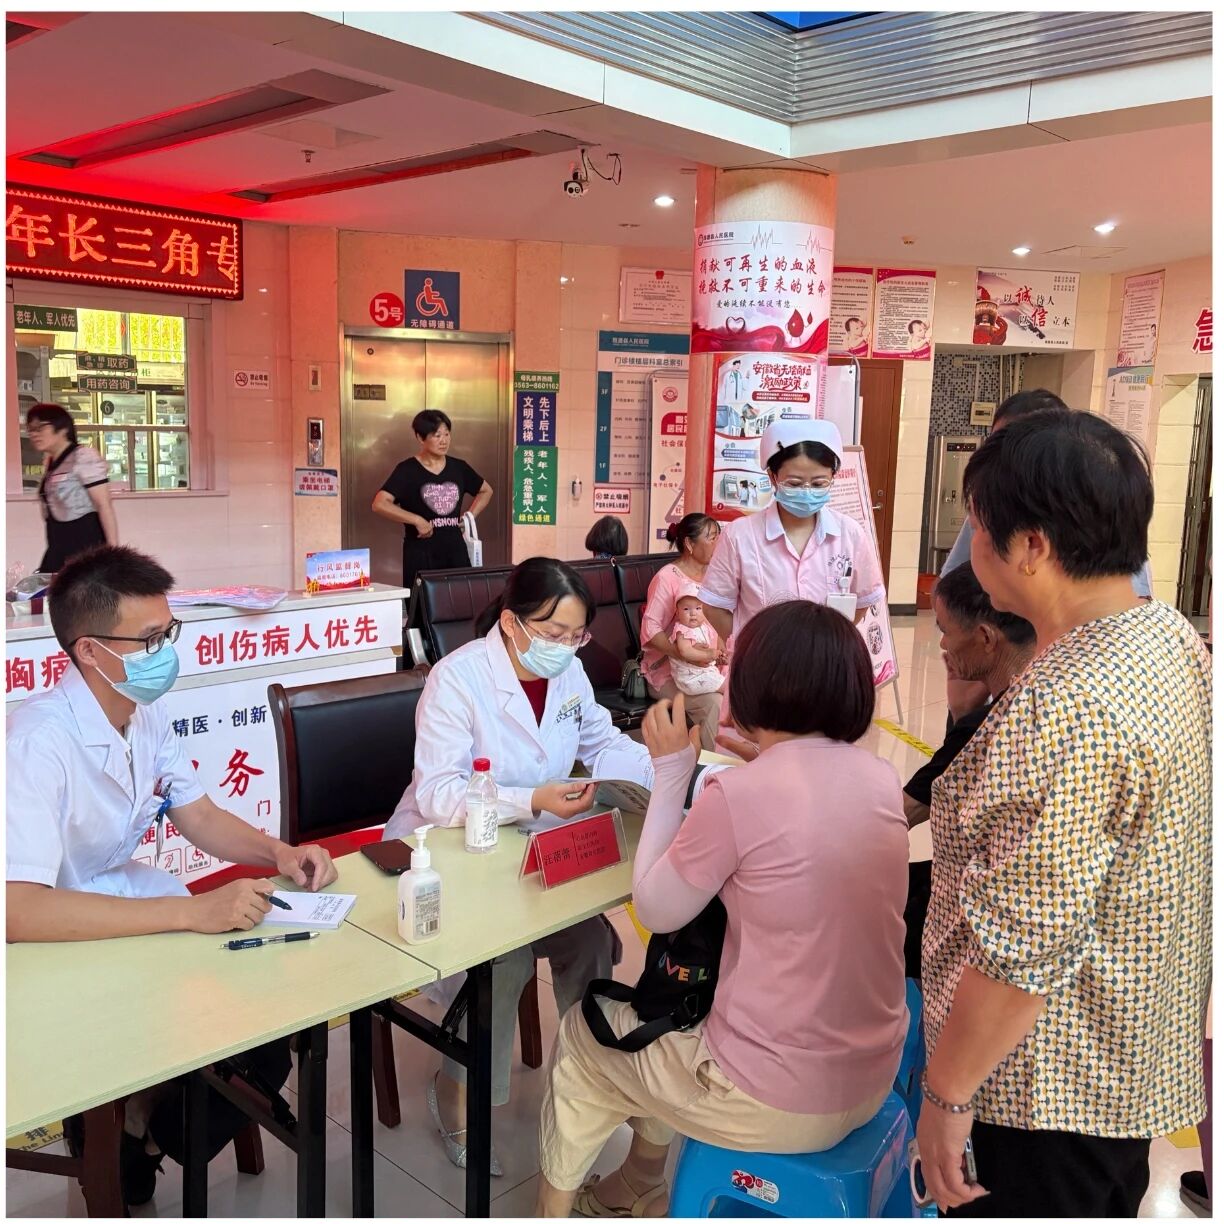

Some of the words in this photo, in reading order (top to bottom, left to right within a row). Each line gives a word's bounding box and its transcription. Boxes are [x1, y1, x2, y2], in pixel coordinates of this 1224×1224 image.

[6, 204, 235, 281] 年长三角专
[16, 310, 76, 328] 老年人、军人优先
[374, 298, 404, 322] 5号
[410, 319, 455, 330] 无障碍通道
[107, 357, 129, 369] 取药
[86, 377, 130, 391] 用药咨询
[522, 396, 534, 442] 文明乘梯
[538, 397, 550, 442] 先下后上
[537, 450, 548, 513] 老年人、军人
[518, 514, 551, 523] 绿色通道
[194, 613, 380, 667] 创伤病人优先
